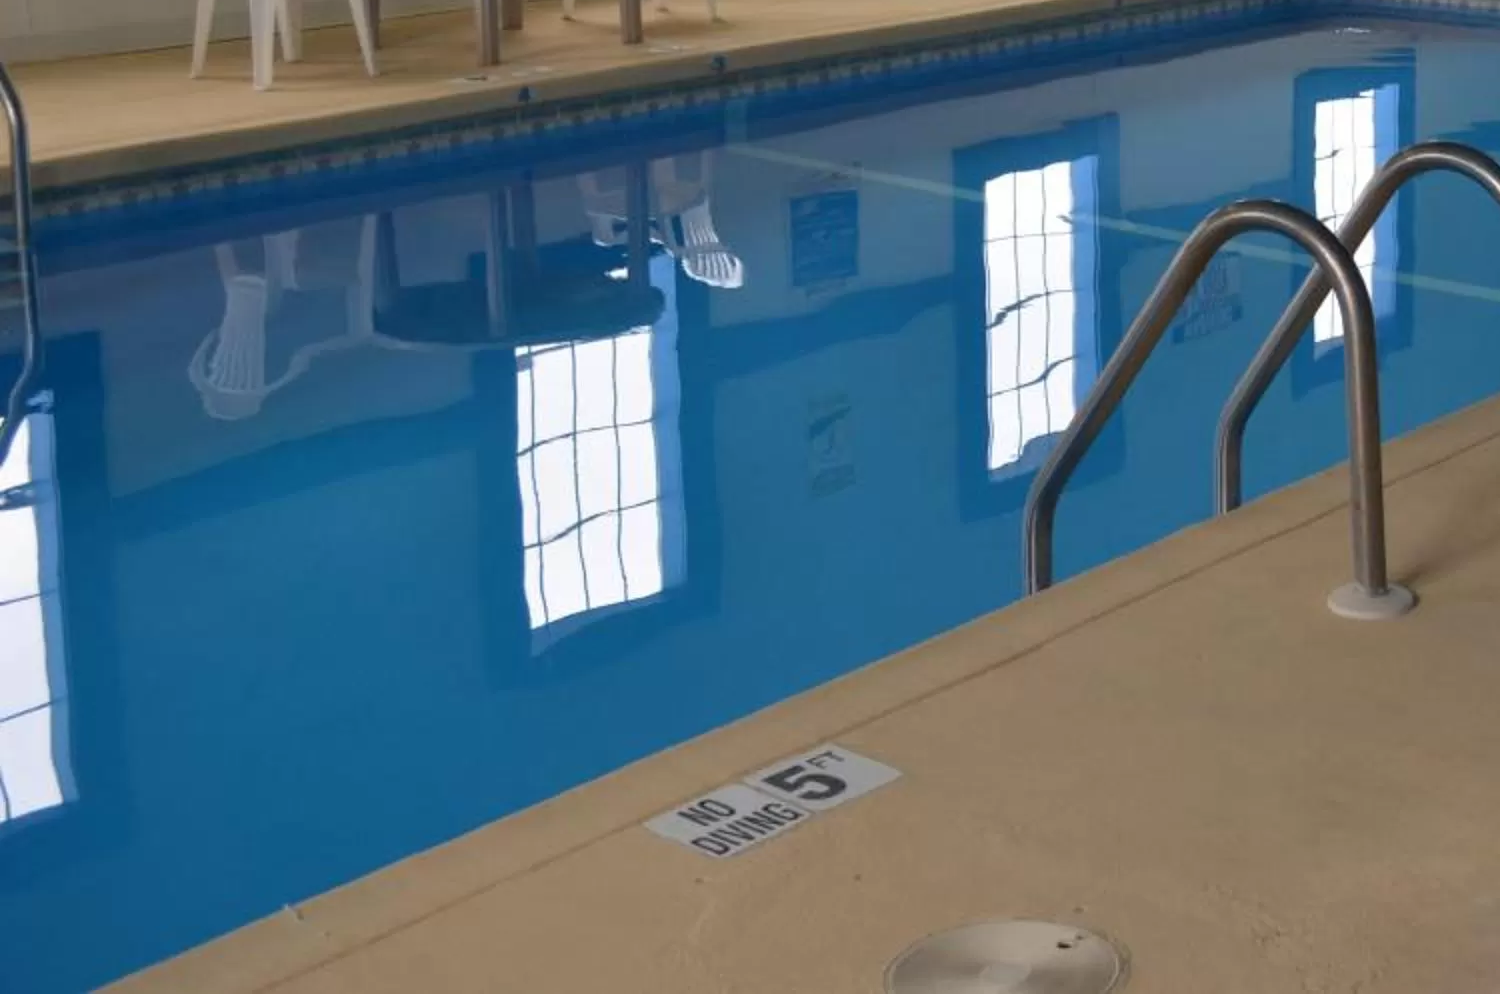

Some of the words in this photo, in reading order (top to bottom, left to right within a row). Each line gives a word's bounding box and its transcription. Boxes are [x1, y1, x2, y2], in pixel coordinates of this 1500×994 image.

[761, 764, 847, 801] 5
[806, 750, 846, 770] FT
[677, 799, 737, 827] NO
[691, 802, 804, 857] DIVING
